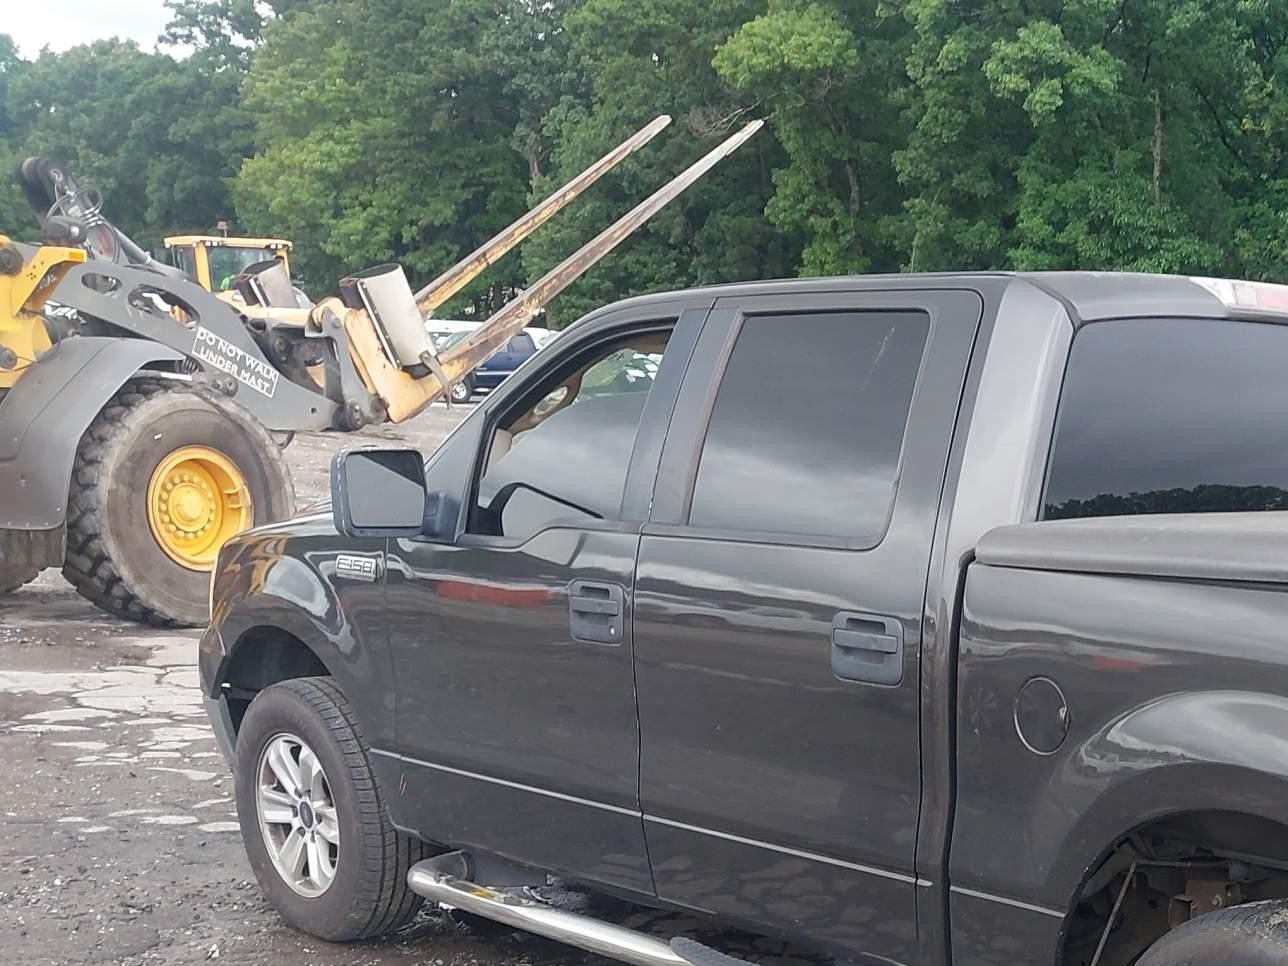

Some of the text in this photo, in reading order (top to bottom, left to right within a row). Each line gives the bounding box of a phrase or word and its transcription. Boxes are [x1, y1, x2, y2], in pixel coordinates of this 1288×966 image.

[197, 328, 276, 383] DO NOT WALK
[200, 346, 271, 394] UNDER MAST
